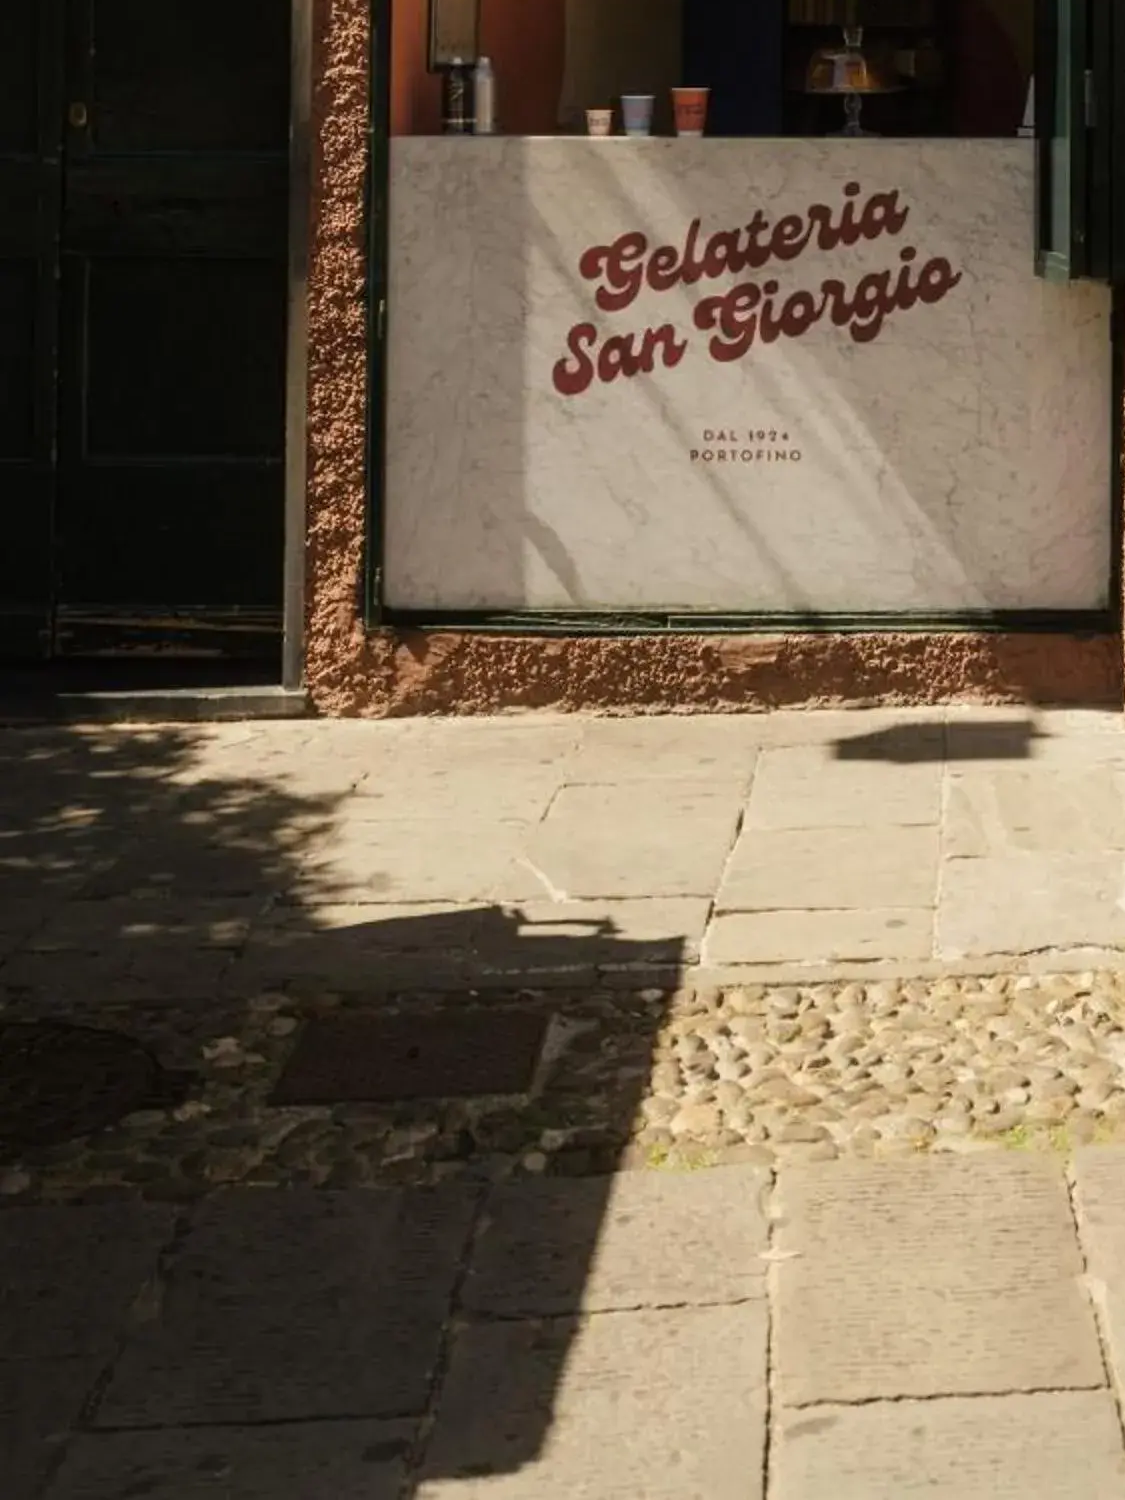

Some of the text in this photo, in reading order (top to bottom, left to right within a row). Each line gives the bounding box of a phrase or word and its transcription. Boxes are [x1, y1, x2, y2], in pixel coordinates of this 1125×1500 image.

[578, 181, 909, 311] Gelateria
[552, 245, 963, 396] San Giorgio
[689, 449, 802, 462] PORTOFINO
[703, 429, 738, 442] DAL
